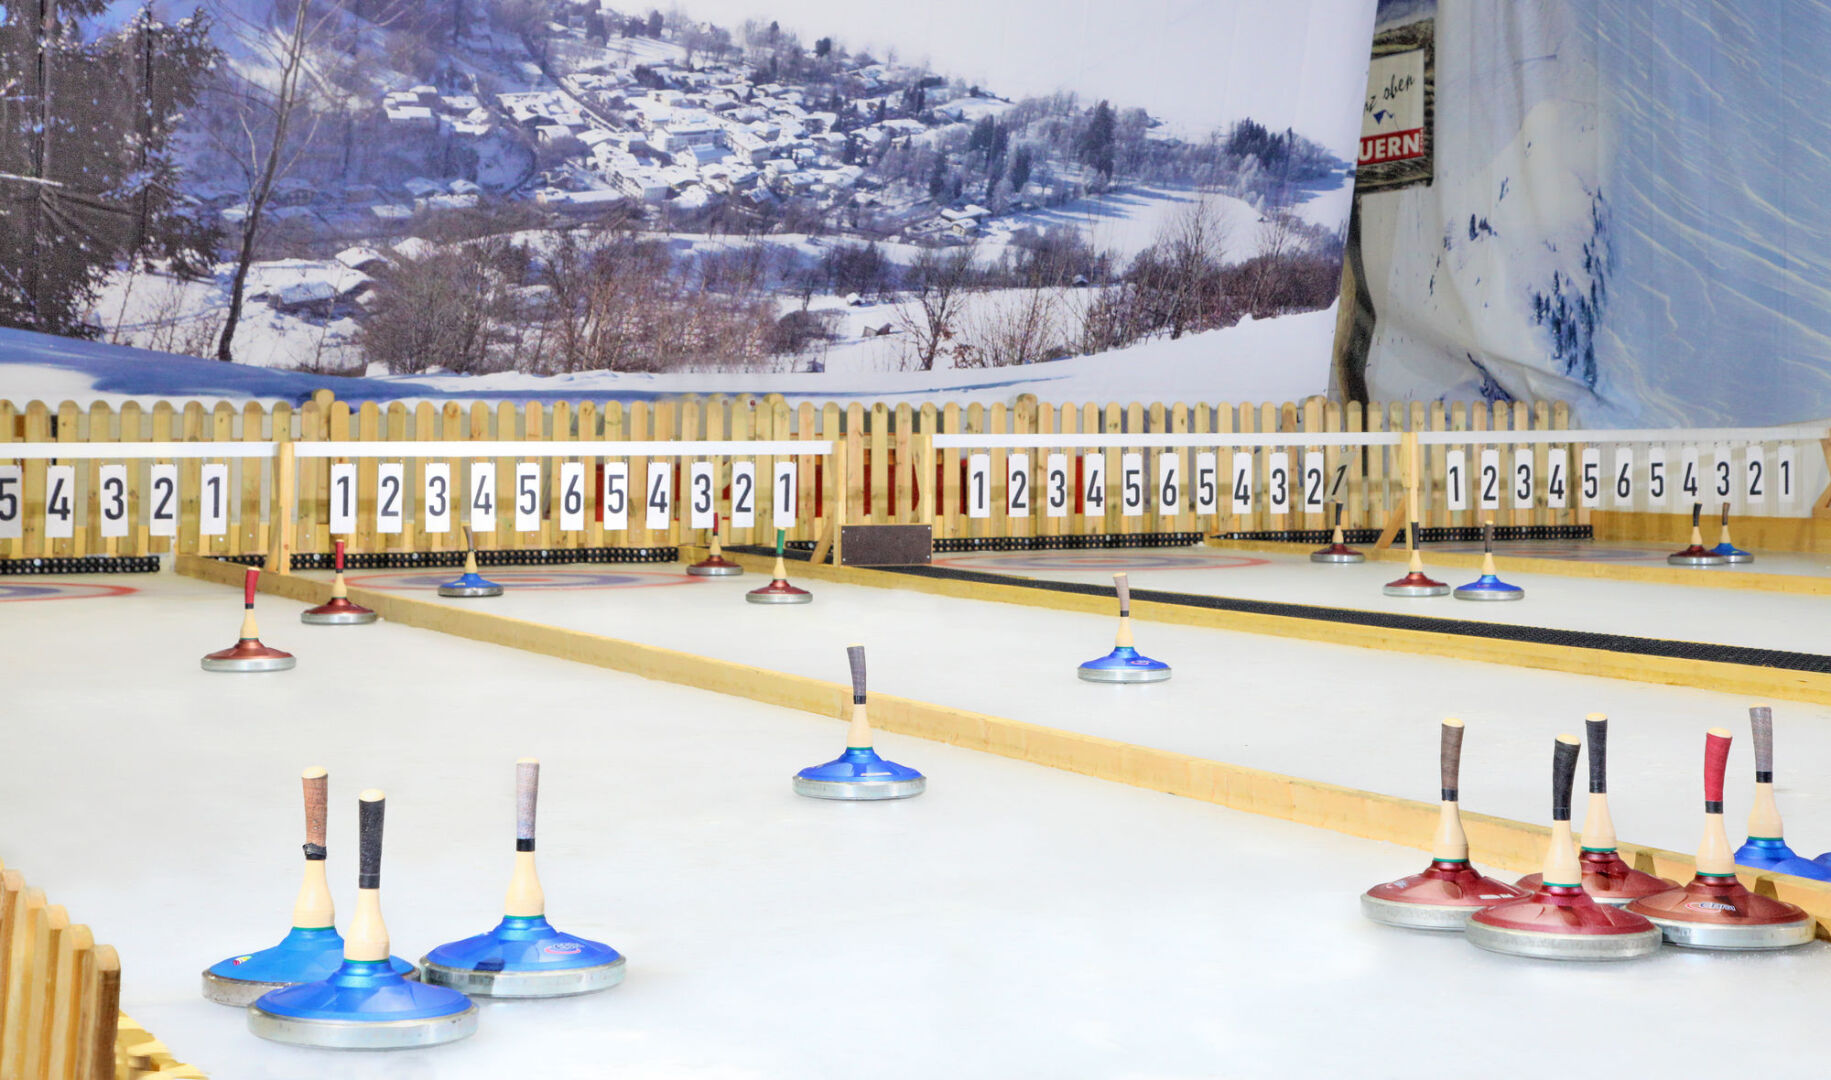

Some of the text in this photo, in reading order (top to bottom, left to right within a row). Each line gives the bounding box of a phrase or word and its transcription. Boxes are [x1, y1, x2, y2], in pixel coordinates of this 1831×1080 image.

[1384, 74, 1415, 100] oben
[1359, 133, 1420, 161] UERN
[0, 476, 220, 522] 5 4 3 2 1
[336, 473, 791, 517] 1 2 3 4 5 6 5 4 3 2 1
[973, 470, 984, 510] 1
[1011, 470, 1027, 509] 2
[1050, 469, 1065, 508] 3
[1086, 469, 1104, 508] 4
[1125, 469, 1141, 508] 5
[1162, 469, 1177, 507] 6
[1199, 468, 1214, 506] 5
[1234, 468, 1251, 506] 4
[1272, 468, 1286, 506] 3
[1307, 468, 1322, 505] 2
[1449, 460, 1789, 502] 1 2 3 4 5 6 5 4 3 2 1
